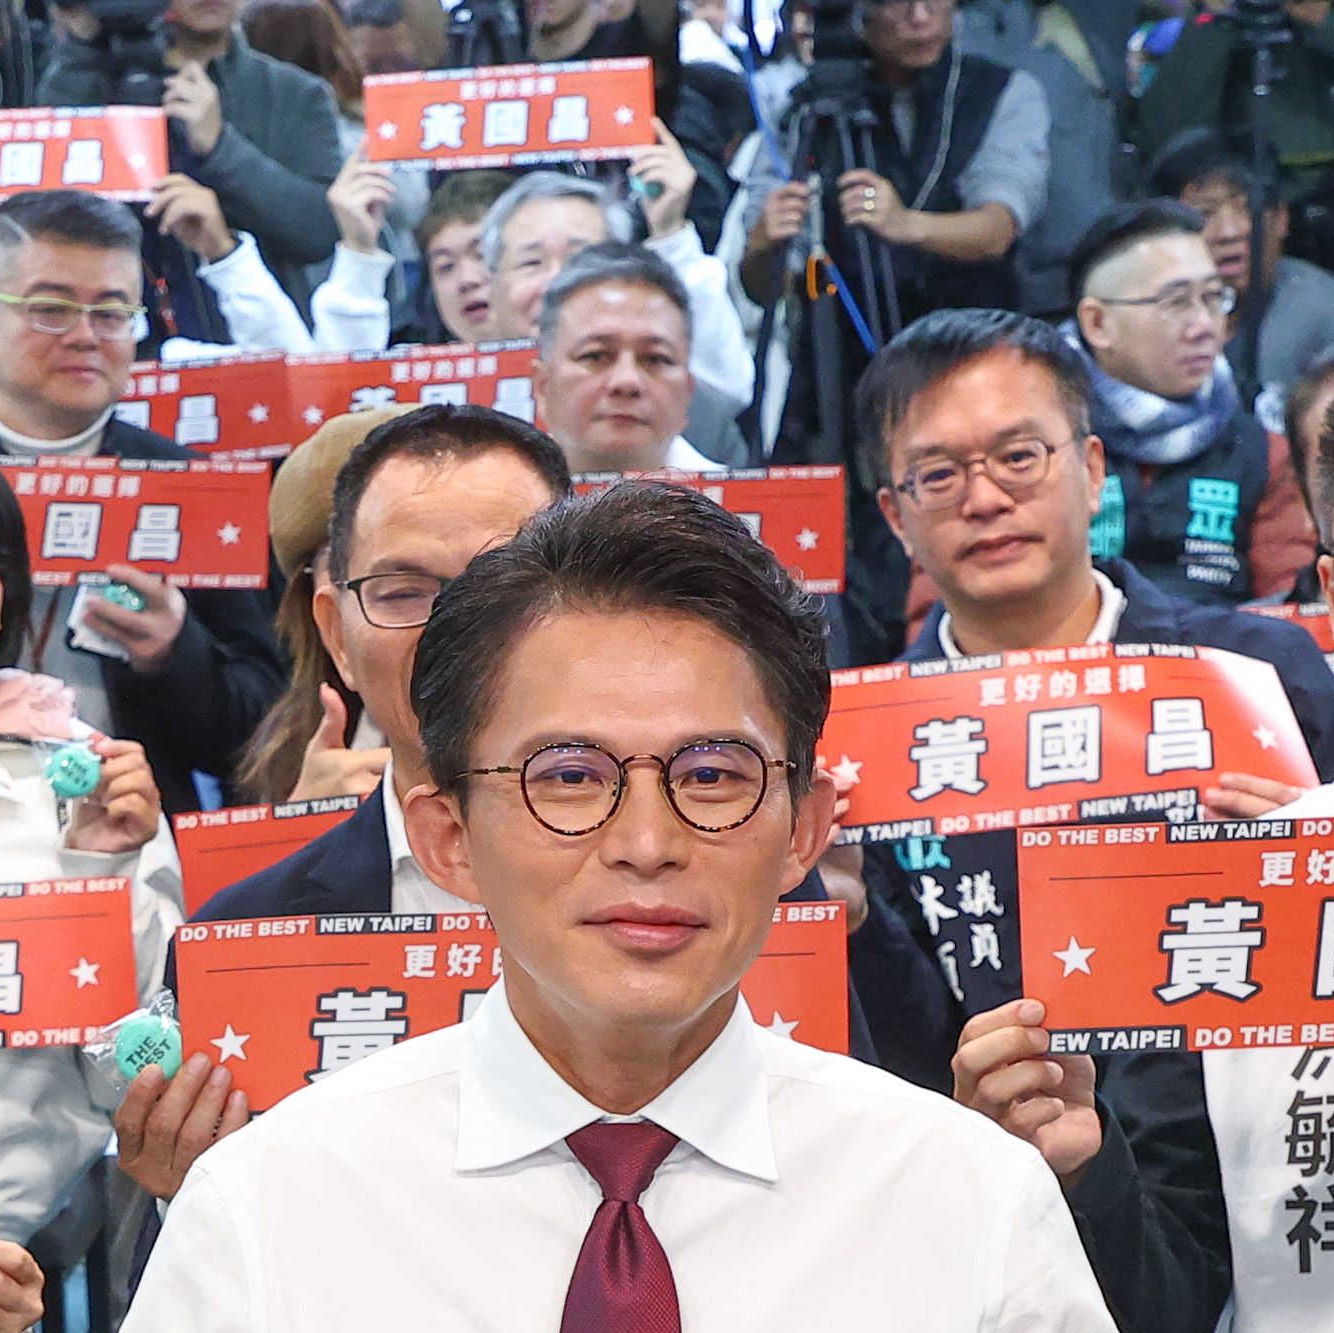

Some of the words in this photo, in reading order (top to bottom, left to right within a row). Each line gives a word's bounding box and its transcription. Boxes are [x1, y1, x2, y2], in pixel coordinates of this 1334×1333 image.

[978, 663, 1146, 707] 更好的選擇
[909, 697, 1214, 801] 黃國昌
[177, 816, 198, 829] DO
[201, 812, 228, 825] THE
[230, 807, 267, 823] BEST
[274, 802, 309, 818] NEW
[310, 796, 358, 813] TAIPEI
[1022, 831, 1052, 847] DO
[1057, 829, 1099, 845] THE
[1105, 827, 1159, 844] BEST
[1170, 824, 1219, 841] NEW
[1223, 821, 1291, 839] TAIPEI
[1302, 819, 1332, 836] DO
[180, 925, 209, 942] DO
[213, 923, 253, 939] THE
[258, 919, 309, 936] BEST
[320, 917, 365, 933] NEW
[369, 916, 432, 932] TAIPEI
[442, 915, 471, 931] DO
[787, 905, 840, 922] BEST
[126, 1037, 156, 1065] THE
[1097, 1029, 1181, 1051] TAIPEI
[1195, 1027, 1232, 1047] DO
[1240, 1025, 1293, 1045] THE
